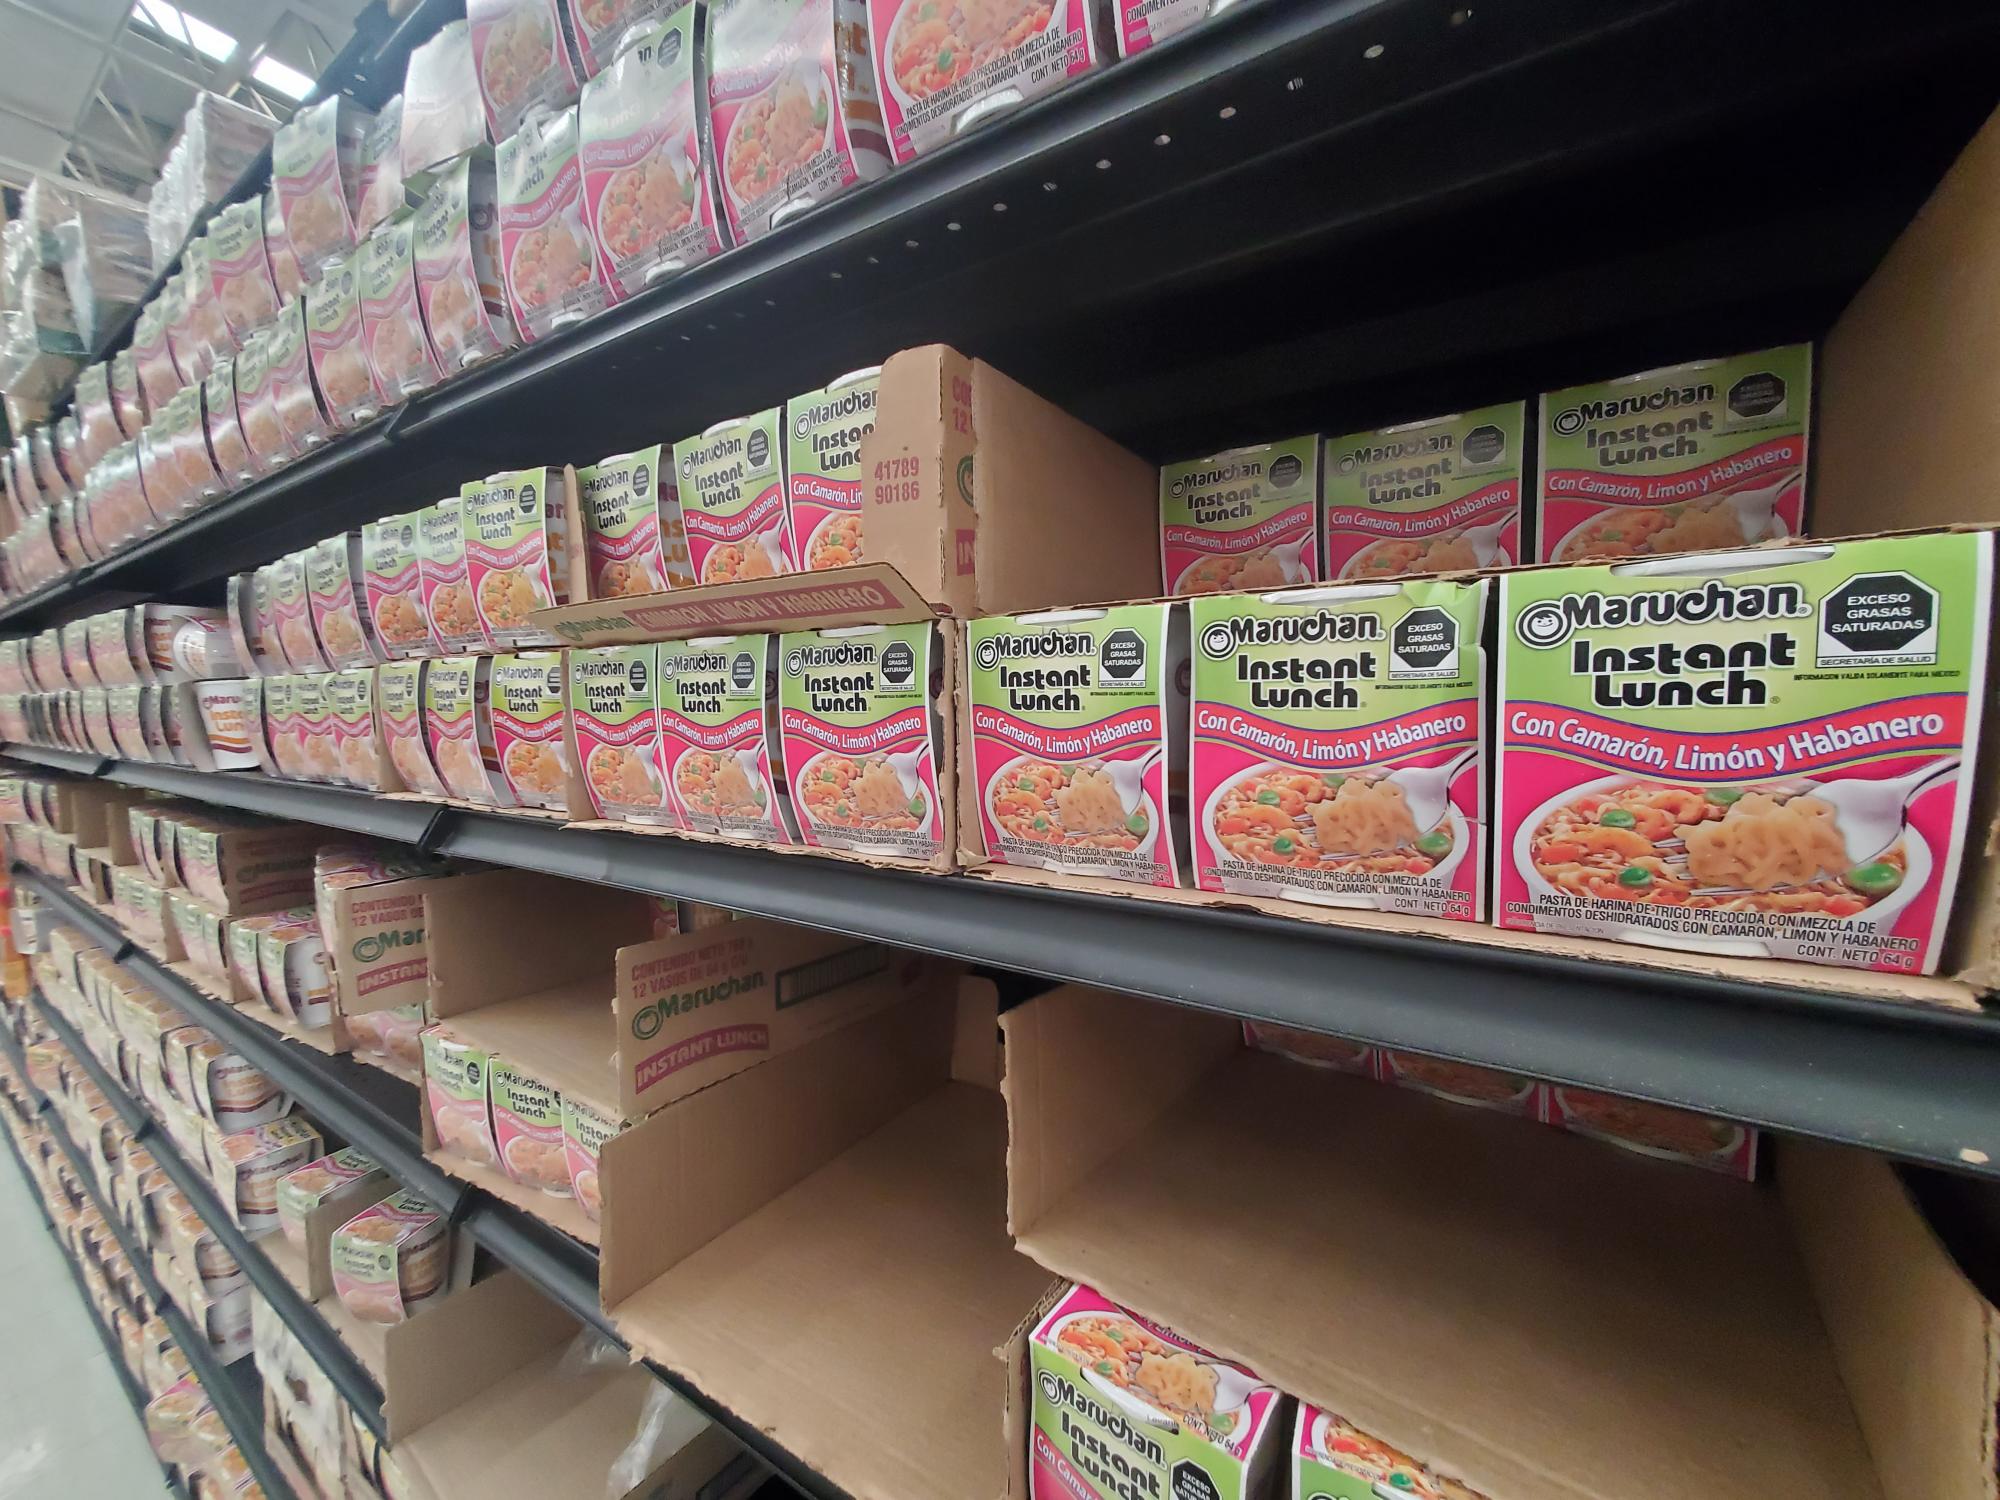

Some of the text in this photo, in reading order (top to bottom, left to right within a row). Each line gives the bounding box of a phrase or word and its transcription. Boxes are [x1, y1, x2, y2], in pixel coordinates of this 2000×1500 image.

[1047, 30, 1083, 58] HABANERO
[1582, 384, 1714, 421] Maruchan
[1587, 411, 1713, 448] Instant
[690, 437, 741, 467] Maruchan
[1354, 433, 1453, 464] Maruchan
[1600, 436, 1698, 466] Lunch
[695, 462, 743, 492] Instant
[875, 456, 920, 481] 41789
[1184, 461, 1263, 488] Maruchan
[1360, 458, 1452, 488] Instant
[1550, 476, 1575, 491] Con
[1700, 475, 1709, 490] y
[1710, 447, 1792, 483] Habanero
[702, 483, 740, 508] Lunch
[794, 480, 848, 505] Con Camarón,
[875, 481, 920, 505] 90186
[1188, 486, 1261, 510] Instant
[1369, 480, 1441, 504] Lunch
[1195, 502, 1252, 525] Lunch
[1332, 512, 1352, 525] Con
[1442, 513, 1450, 526] y
[1451, 488, 1510, 518] Habanero
[598, 511, 627, 530] Lunch
[1565, 584, 1798, 627] Maruchan
[1847, 593, 1911, 606] EXCESO
[1846, 607, 1911, 619] GRASAS
[1231, 610, 1379, 643] Maruchan
[1407, 633, 1444, 643] GRASAS
[1408, 623, 1443, 633] EXCESO
[1831, 619, 1925, 633] SATURADAS
[802, 643, 873, 665] Maruchan
[995, 631, 1091, 658] Maruchan
[1110, 650, 1136, 658] GRASAS
[1398, 643, 1451, 653] SATURADAS
[1573, 632, 1796, 674] Instant
[674, 652, 727, 672] Maruchan
[1104, 658, 1141, 666] SATURADAS
[1238, 652, 1376, 682] Instant
[1897, 655, 1931, 663] SALUD
[676, 678, 726, 697] Instant
[804, 672, 874, 694] Instant
[1000, 665, 1090, 690] Instant
[1594, 669, 1766, 706] Lunch
[504, 685, 542, 700] Instant
[585, 682, 626, 699] Instant
[812, 693, 867, 712] Lunch
[1010, 689, 1080, 711] Lunch
[1252, 681, 1358, 708] Lunch
[508, 699, 539, 713] Lunch
[590, 698, 622, 713] Lunch
[681, 695, 721, 713] Lunch
[785, 714, 921, 750] Con Camarón, Limón y Habanero
[976, 712, 1153, 754] Con Camarón, Limón y Habanero
[1199, 710, 1466, 761] Con Camarón, Limón y Habanero
[1511, 711, 1944, 772] Con Camarón, Limón y Habanero
[1223, 860, 1245, 870] PASTA
[1247, 862, 1257, 871] DE
[1258, 865, 1285, 875] HARINA
[1299, 869, 1322, 879] TRIGO
[1324, 871, 1371, 883] PRECOCIDA
[1373, 874, 1390, 884] CON
[1392, 875, 1427, 887] MEZCLA
[1430, 878, 1442, 888] DE
[1255, 872, 1315, 889] DESHIDRATADOS
[1317, 881, 1334, 891] CON
[1383, 886, 1411, 896] LIMON
[1414, 887, 1420, 896] Y
[1421, 889, 1470, 902] HABANERO
[1424, 901, 1447, 912] NETO
[1450, 904, 1461, 913] 64
[1464, 907, 1469, 916] g
[1539, 895, 1876, 934] PASTA DE HARINA DE TRIGO PRECOCIDA CON MEZCLA DE
[1507, 903, 1582, 919] CONDIMENTOS
[1585, 909, 1679, 932] DESHIDRATADOS
[1682, 922, 1709, 934] CON
[1712, 924, 1778, 940] CAMARON,
[1782, 929, 1827, 943] LIMON
[1830, 932, 1841, 943] Y
[1842, 934, 1919, 951] HABANERO
[1797, 945, 1914, 968] CONT. NETO 64 g
[658, 971, 765, 1018] Maruchan
[637, 1037, 712, 1086] INSTANT
[1058, 1376, 1162, 1465] Maruchan
[1037, 1434, 1055, 1464] Con
[1061, 1411, 1160, 1499] Instant
[1183, 1470, 1211, 1494] EXCESO
